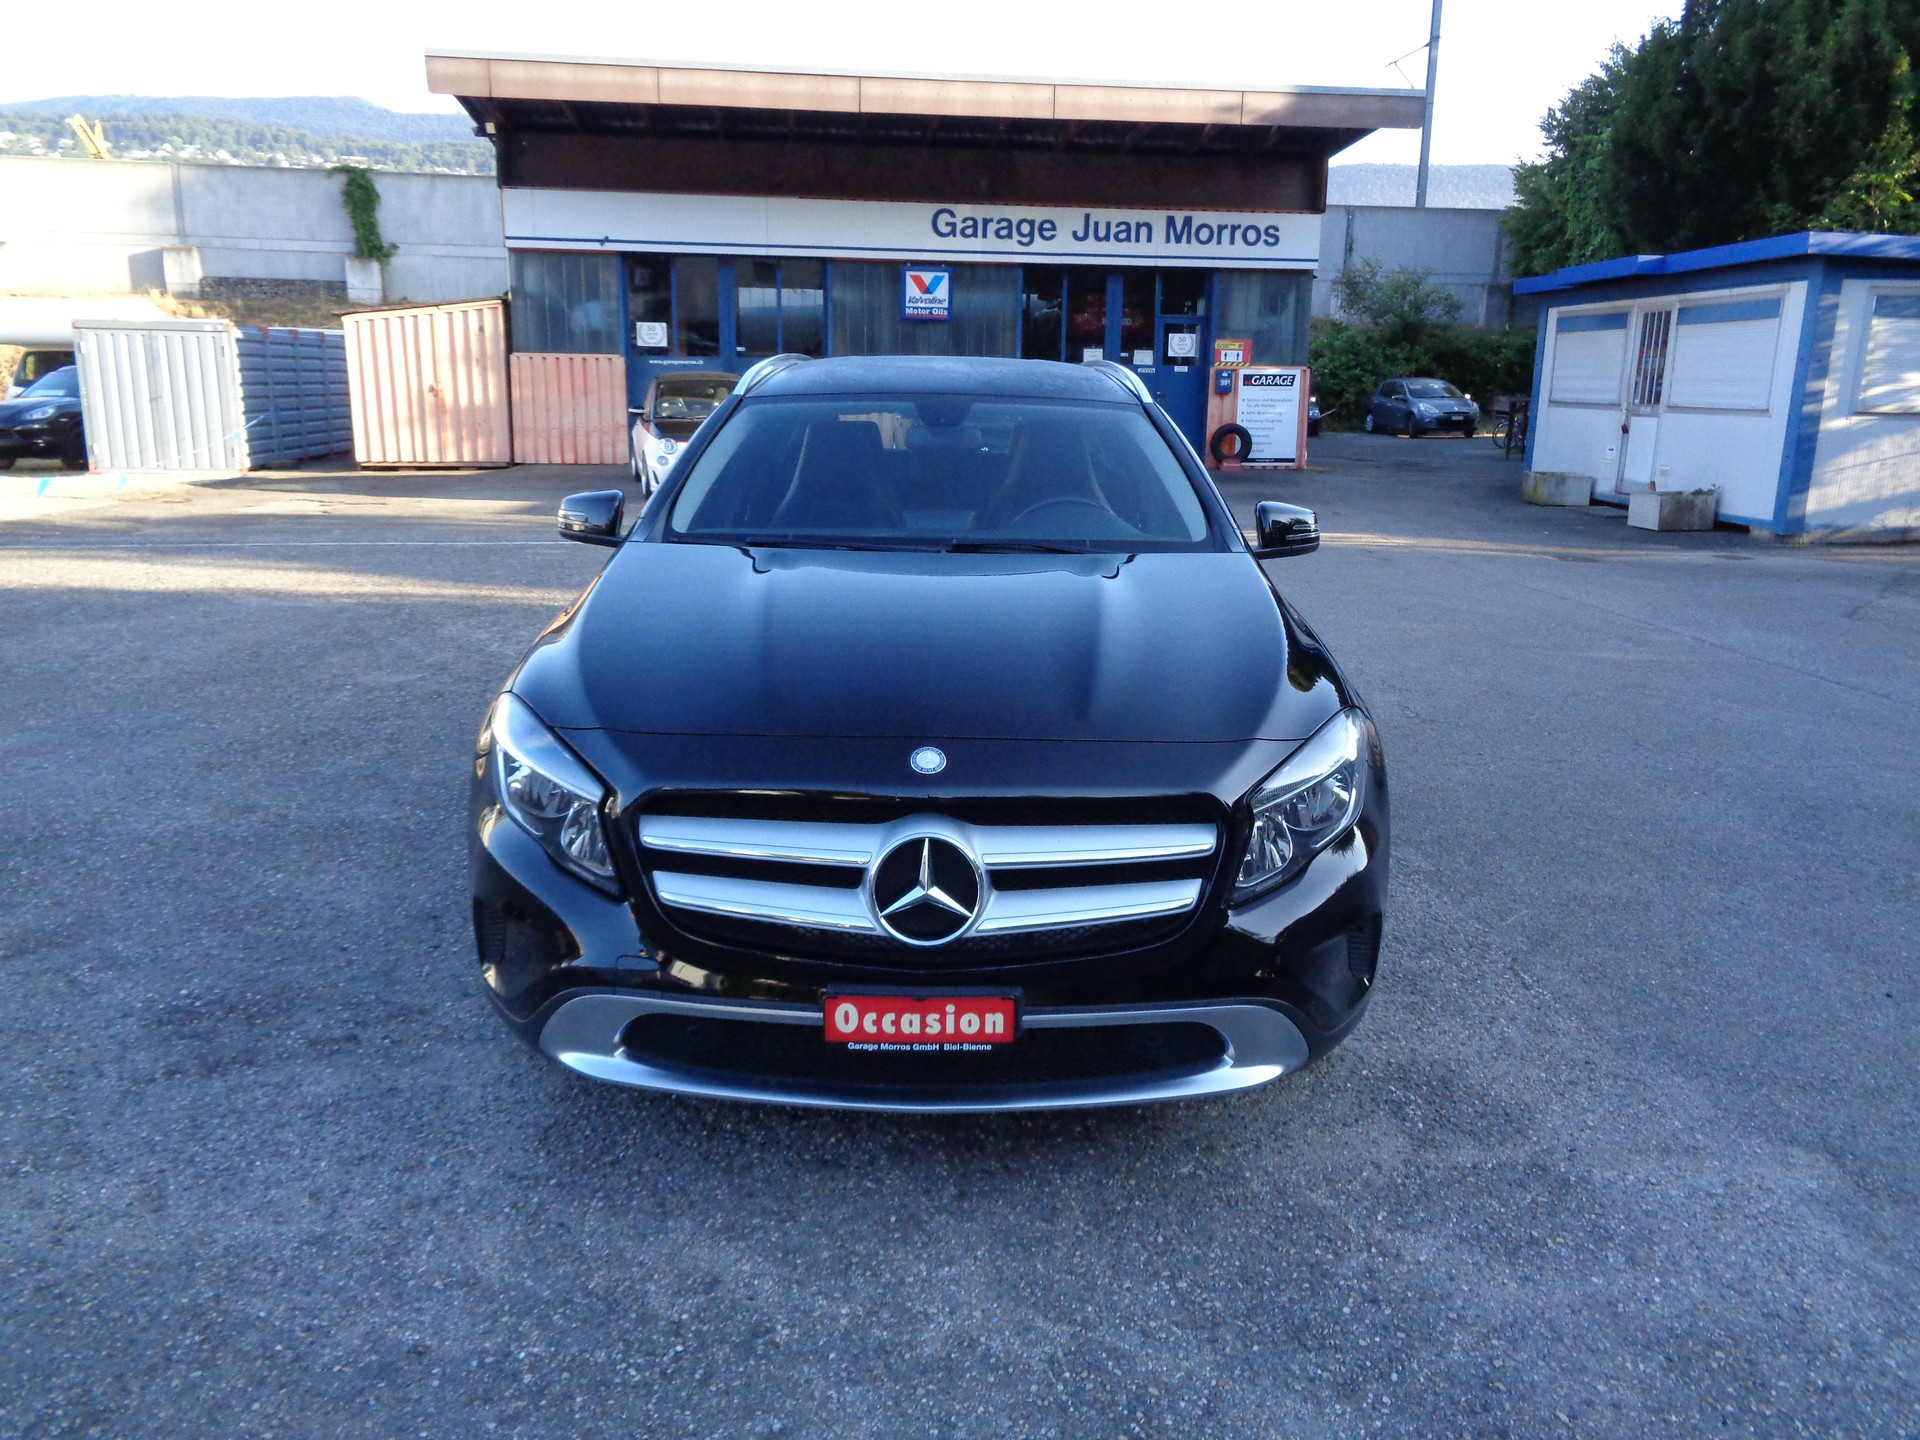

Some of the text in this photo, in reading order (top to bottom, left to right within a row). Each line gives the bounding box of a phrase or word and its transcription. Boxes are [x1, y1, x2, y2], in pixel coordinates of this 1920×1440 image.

[931, 207, 1281, 247] Garage Juan Morros
[907, 295, 945, 305] Valvoline
[905, 307, 948, 316] Motor Oils
[1251, 375, 1294, 386] GARAGE
[834, 1002, 1005, 1035] Occasion
[847, 1042, 992, 1051] Garage Morros GmbH Biel-Bienne
